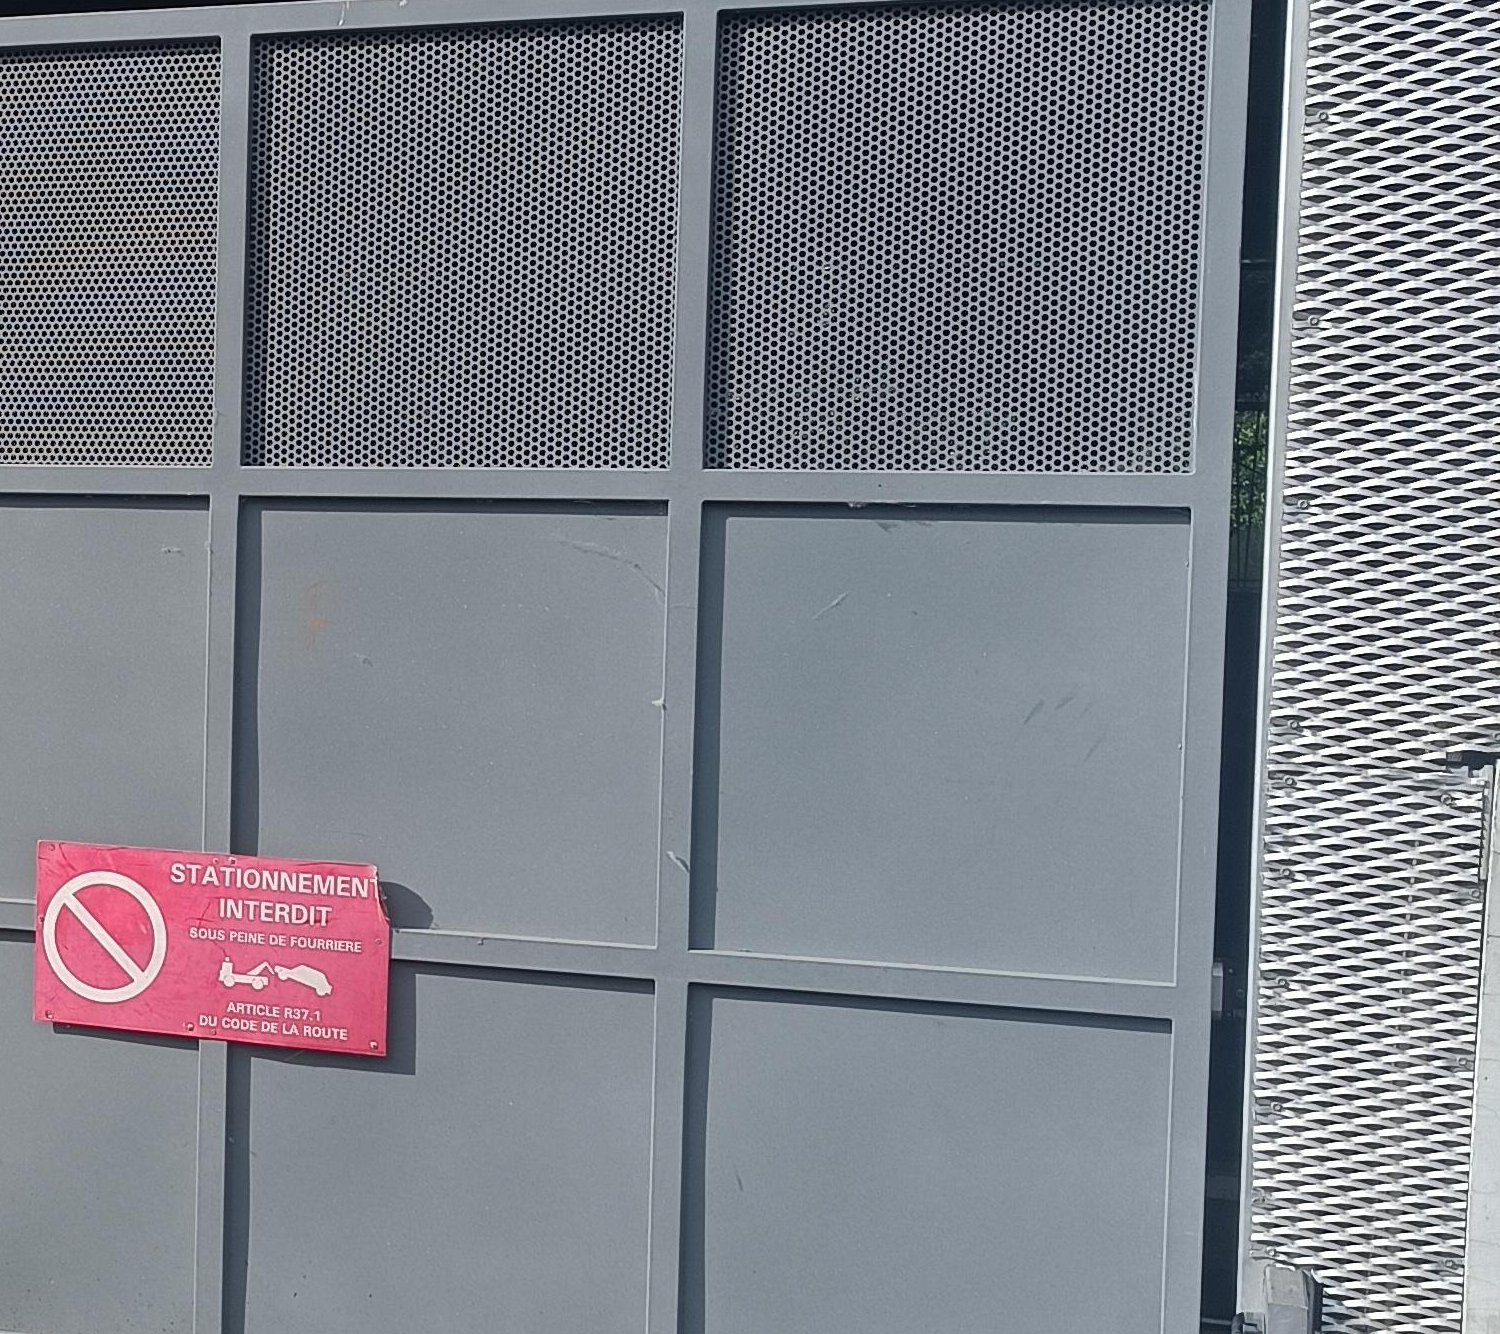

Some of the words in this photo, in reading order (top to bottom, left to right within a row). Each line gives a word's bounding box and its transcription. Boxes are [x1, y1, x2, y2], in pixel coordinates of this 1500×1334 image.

[219, 898, 332, 927] INTERDIT
[189, 927, 226, 941] SOUS
[229, 930, 266, 945] PEINE
[269, 934, 287, 946] DE
[290, 936, 363, 953] FOURRIERE
[226, 1001, 280, 1018] ARTICLE
[284, 1007, 321, 1021] R37.1
[199, 1015, 218, 1026] DU
[222, 1017, 257, 1031] CODE
[261, 1021, 278, 1033] DE
[282, 1022, 299, 1036] LA
[303, 1025, 349, 1040] ROUTE
